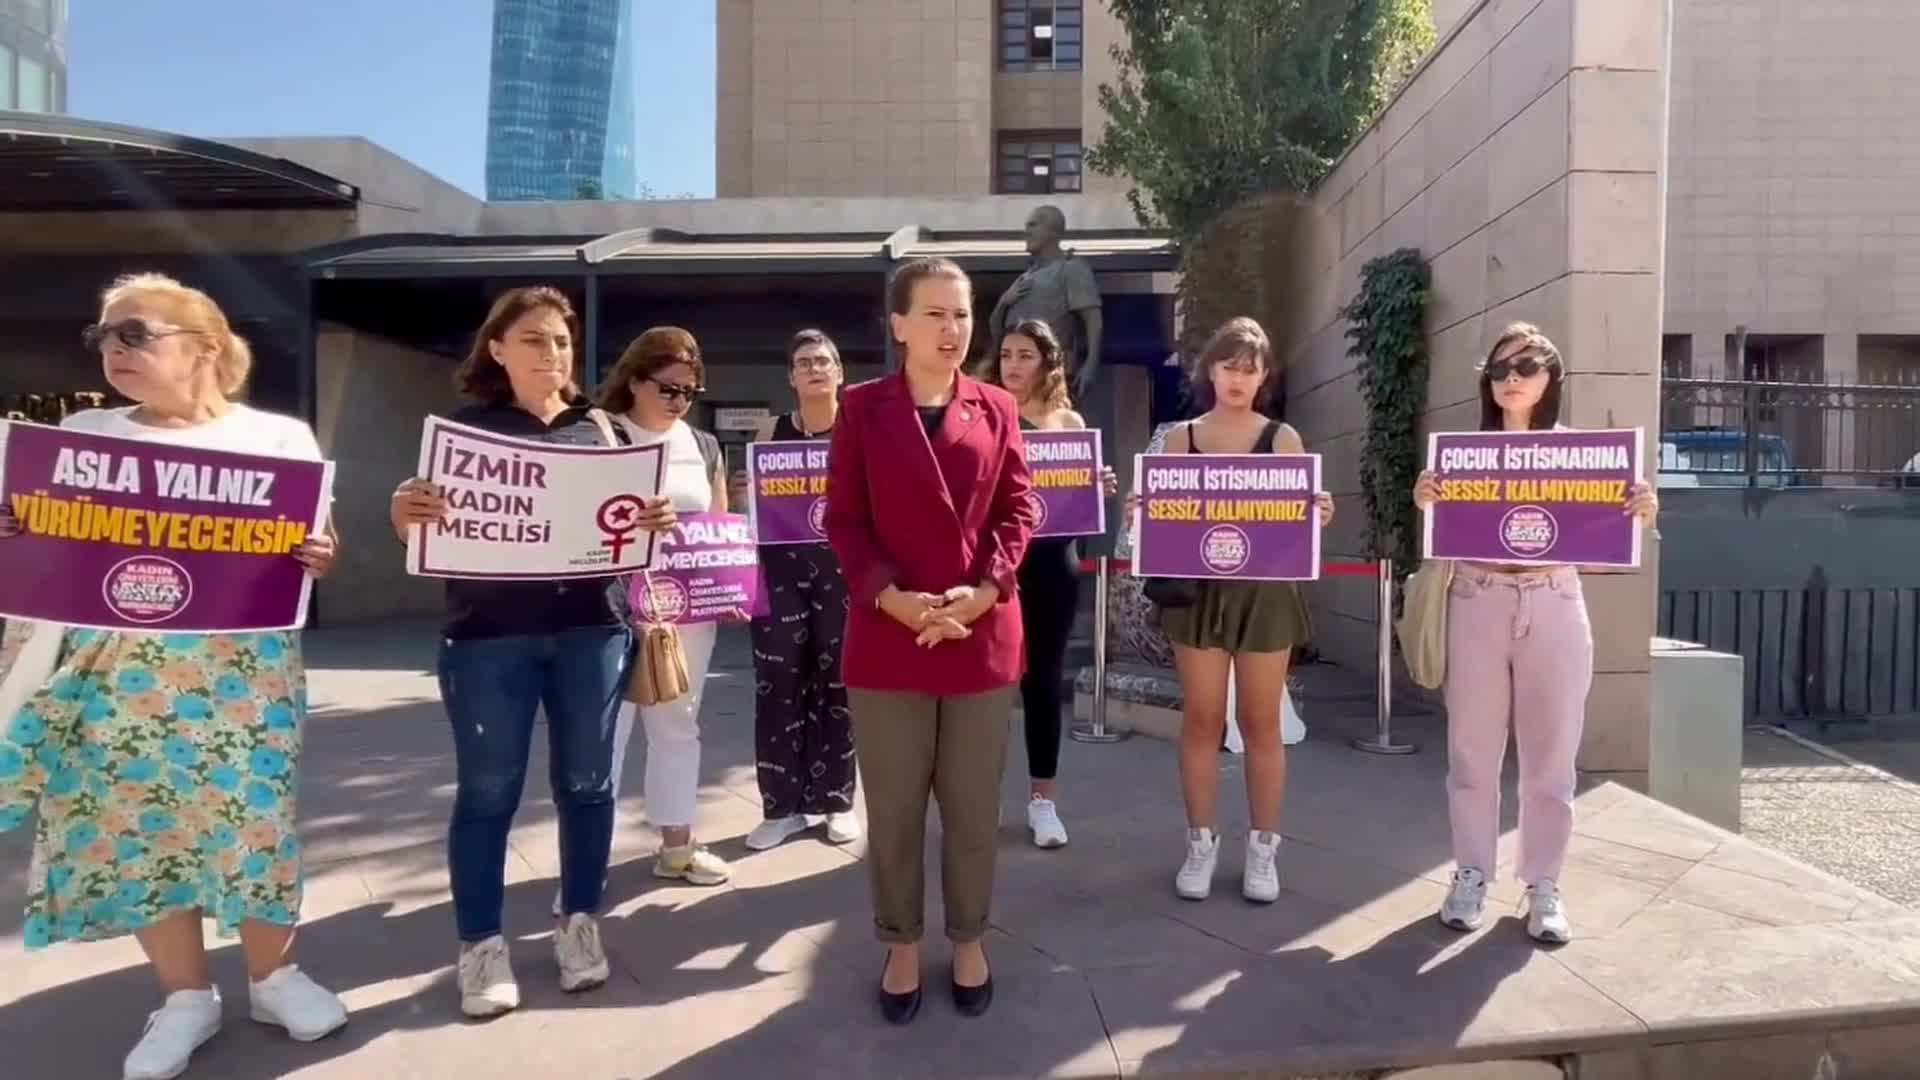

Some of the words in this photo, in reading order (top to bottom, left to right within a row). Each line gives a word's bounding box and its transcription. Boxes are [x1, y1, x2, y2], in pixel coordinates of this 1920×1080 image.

[441, 438, 547, 489] İZMİR
[758, 451, 804, 474] ÇOCUK
[1440, 446, 1499, 474] ÇOCUK
[1503, 444, 1629, 471] İSTİSMARINA
[52, 447, 141, 494] ASLA
[153, 459, 275, 507] YALNIZ
[760, 474, 808, 496] SESSİZ
[1147, 466, 1200, 494] ÇOCUK
[1203, 466, 1309, 491] İSTİSMARINA
[1439, 475, 1500, 501] SESSİZ
[1505, 478, 1627, 503] KALMIYORUZ
[438, 484, 534, 518] KADIN
[1147, 495, 1201, 521] SESSİZ
[1204, 499, 1308, 522] KALMIYORUZ
[11, 488, 307, 555] YÜRÜMEYECEKSİN
[436, 516, 552, 544] MECLİSİ
[126, 563, 174, 576] KADIN
